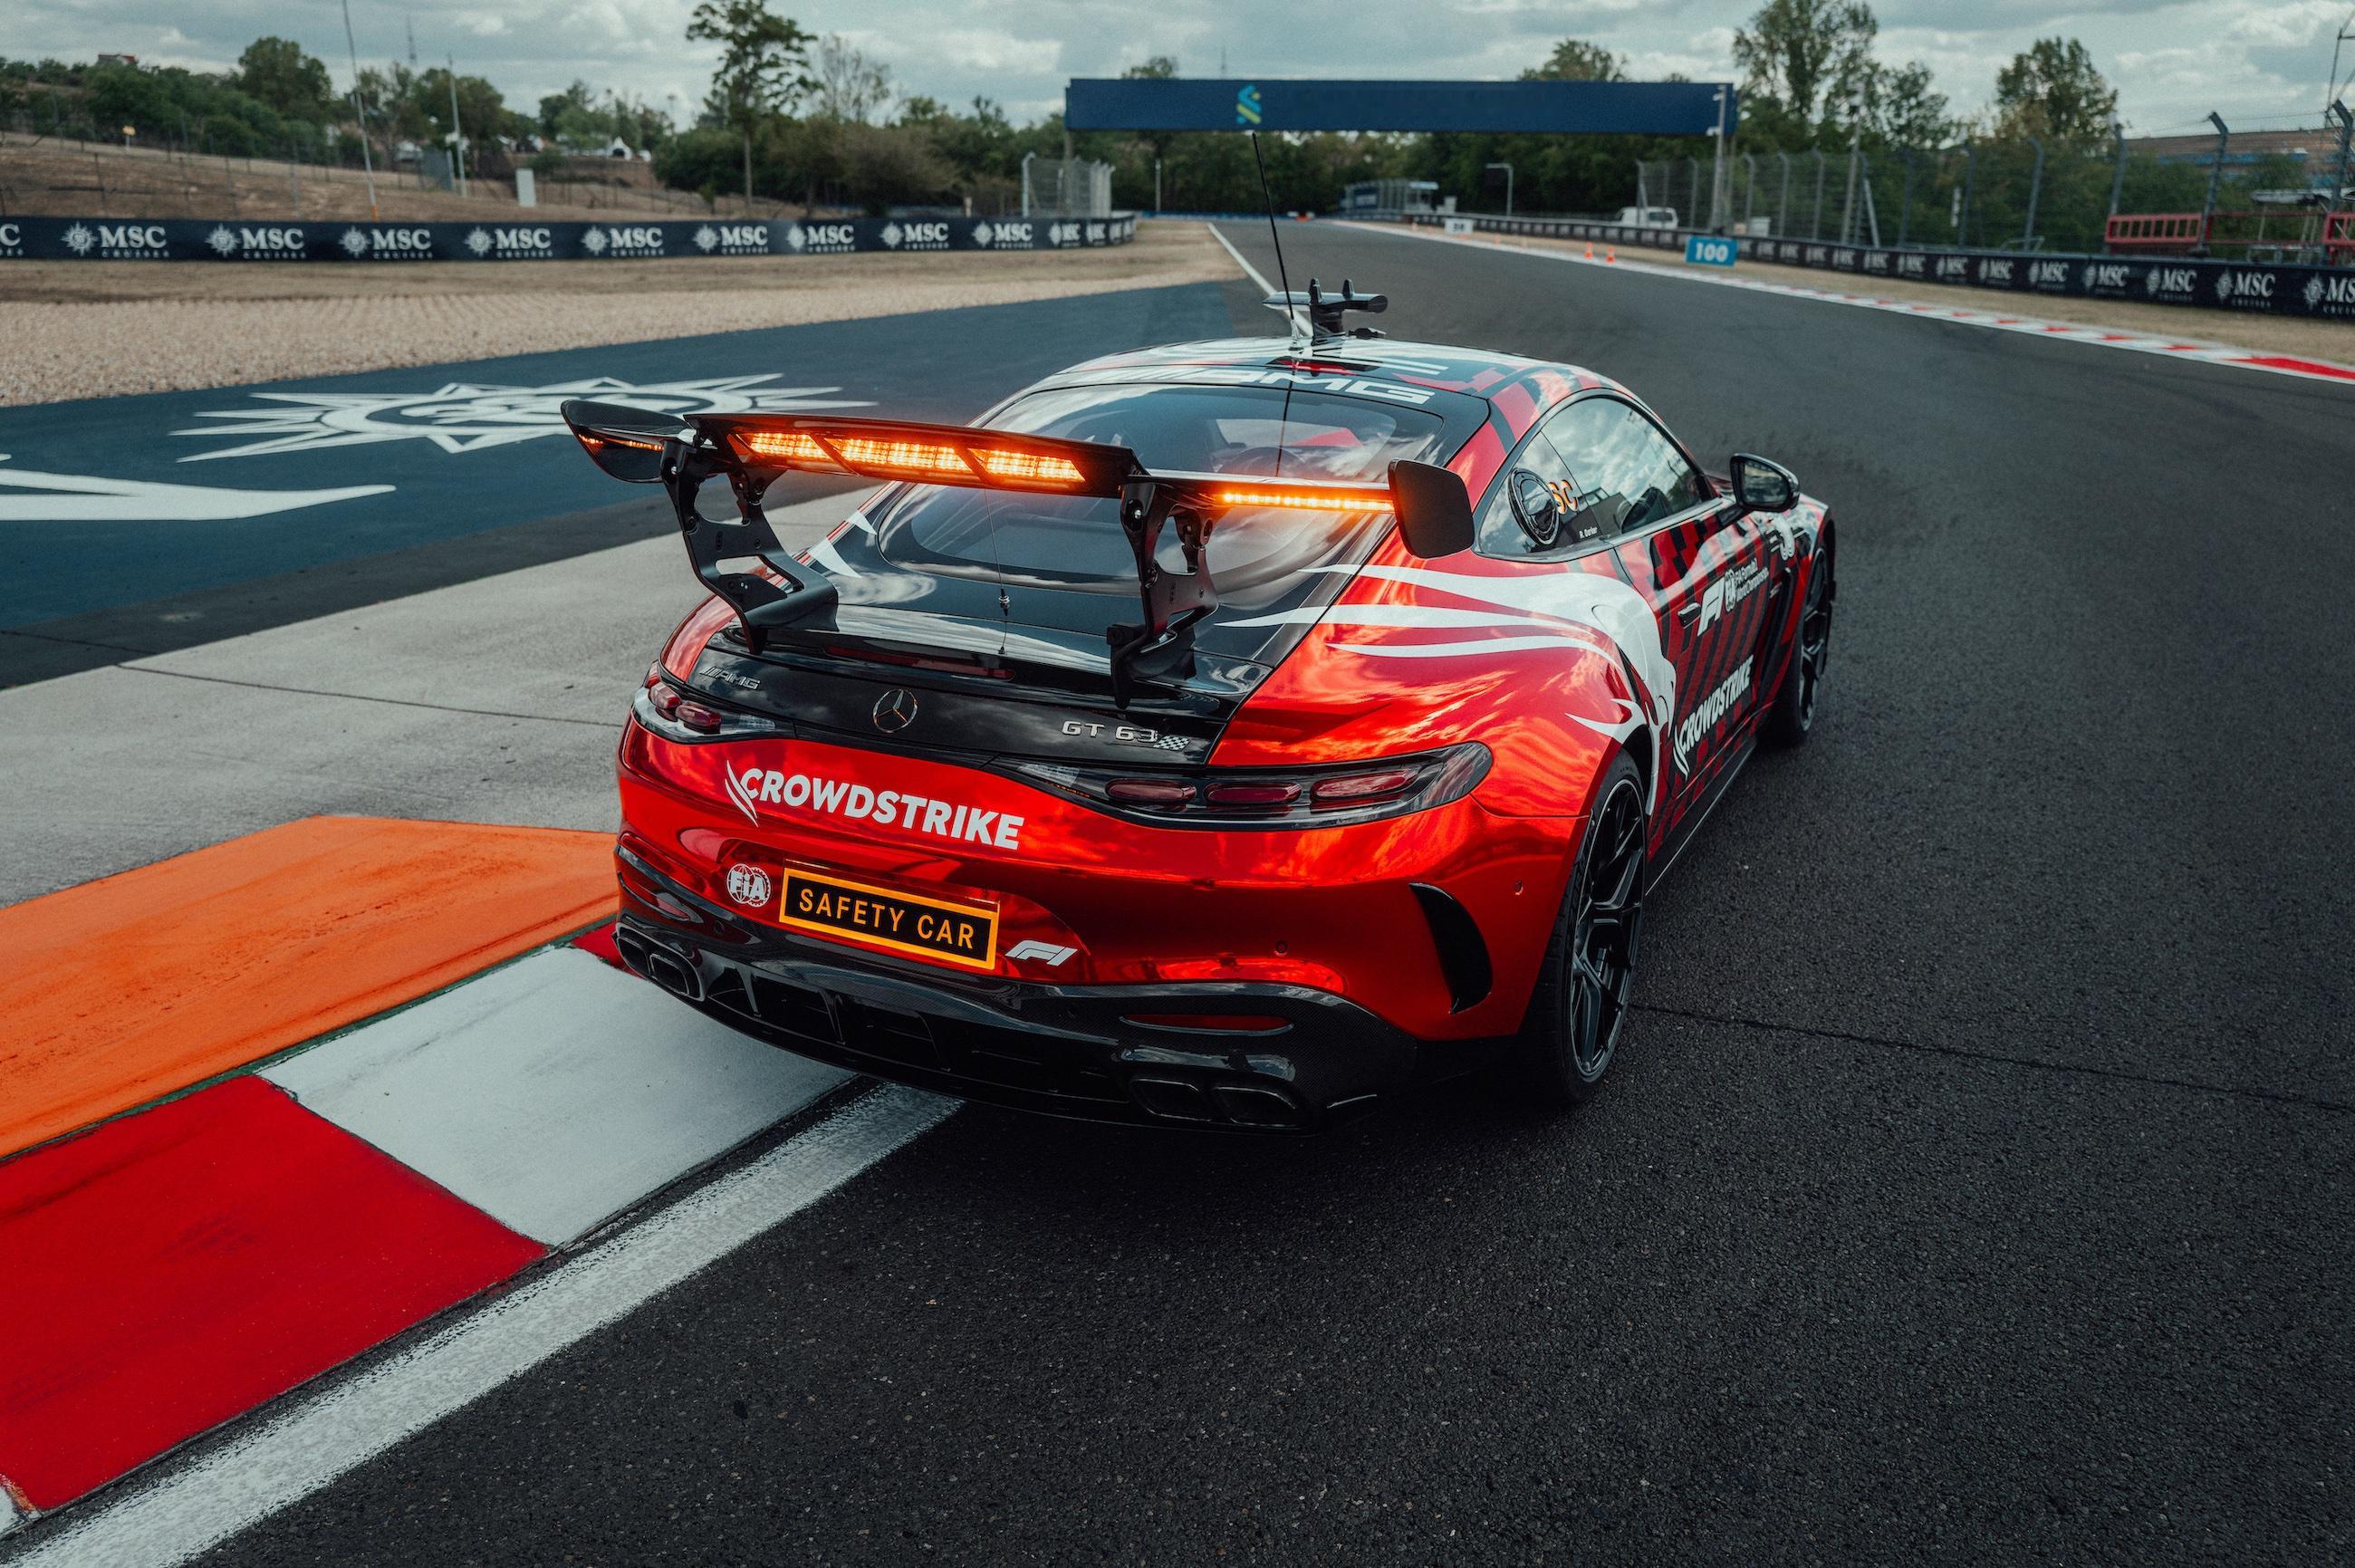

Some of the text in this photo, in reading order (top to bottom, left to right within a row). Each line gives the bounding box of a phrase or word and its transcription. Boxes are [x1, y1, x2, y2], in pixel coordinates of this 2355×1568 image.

[98, 225, 168, 248] MSC
[240, 227, 304, 250] MSC
[370, 228, 431, 250] MSC
[495, 227, 552, 250] MSC
[609, 226, 663, 248] MSC
[720, 225, 768, 246] MSC
[807, 225, 855, 245] MSC
[904, 222, 949, 243] MSC
[994, 222, 1033, 242] MSC
[1695, 242, 1729, 263] 100
[2096, 264, 2130, 287] MSC
[2160, 267, 2197, 293] MSC
[2234, 271, 2276, 298] MSC
[2325, 275, 2355, 303] MS
[1181, 367, 1436, 405] AMG
[1548, 480, 1578, 515] SC
[715, 669, 761, 690] AMG
[1678, 654, 1754, 755] CROWDSTRIKE
[1062, 720, 1158, 743] GT 63
[741, 767, 1025, 851] CROWDSTRIKE
[799, 888, 974, 950] SAFETY CAR
[1004, 938, 1078, 967] F1
